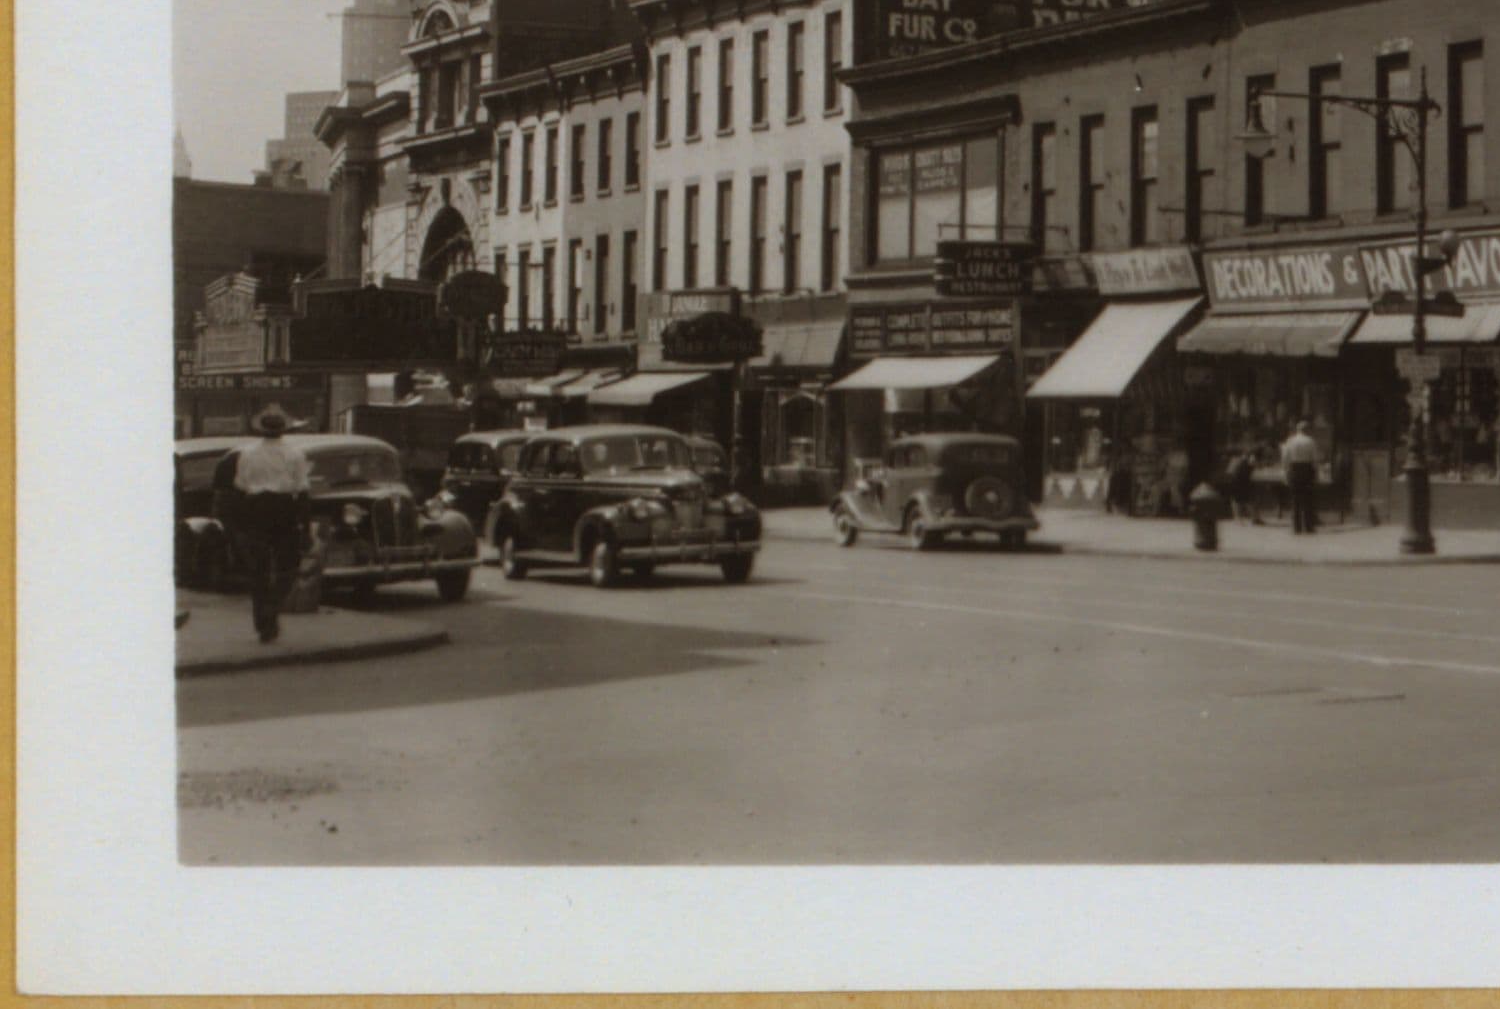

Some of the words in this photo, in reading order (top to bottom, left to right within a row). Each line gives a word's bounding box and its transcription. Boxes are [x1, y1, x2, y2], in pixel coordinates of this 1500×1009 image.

[888, 12, 938, 41] FUR
[956, 261, 1020, 280] LUNCH
[1211, 252, 1337, 300] DECORATIONS
[1341, 255, 1359, 285] &
